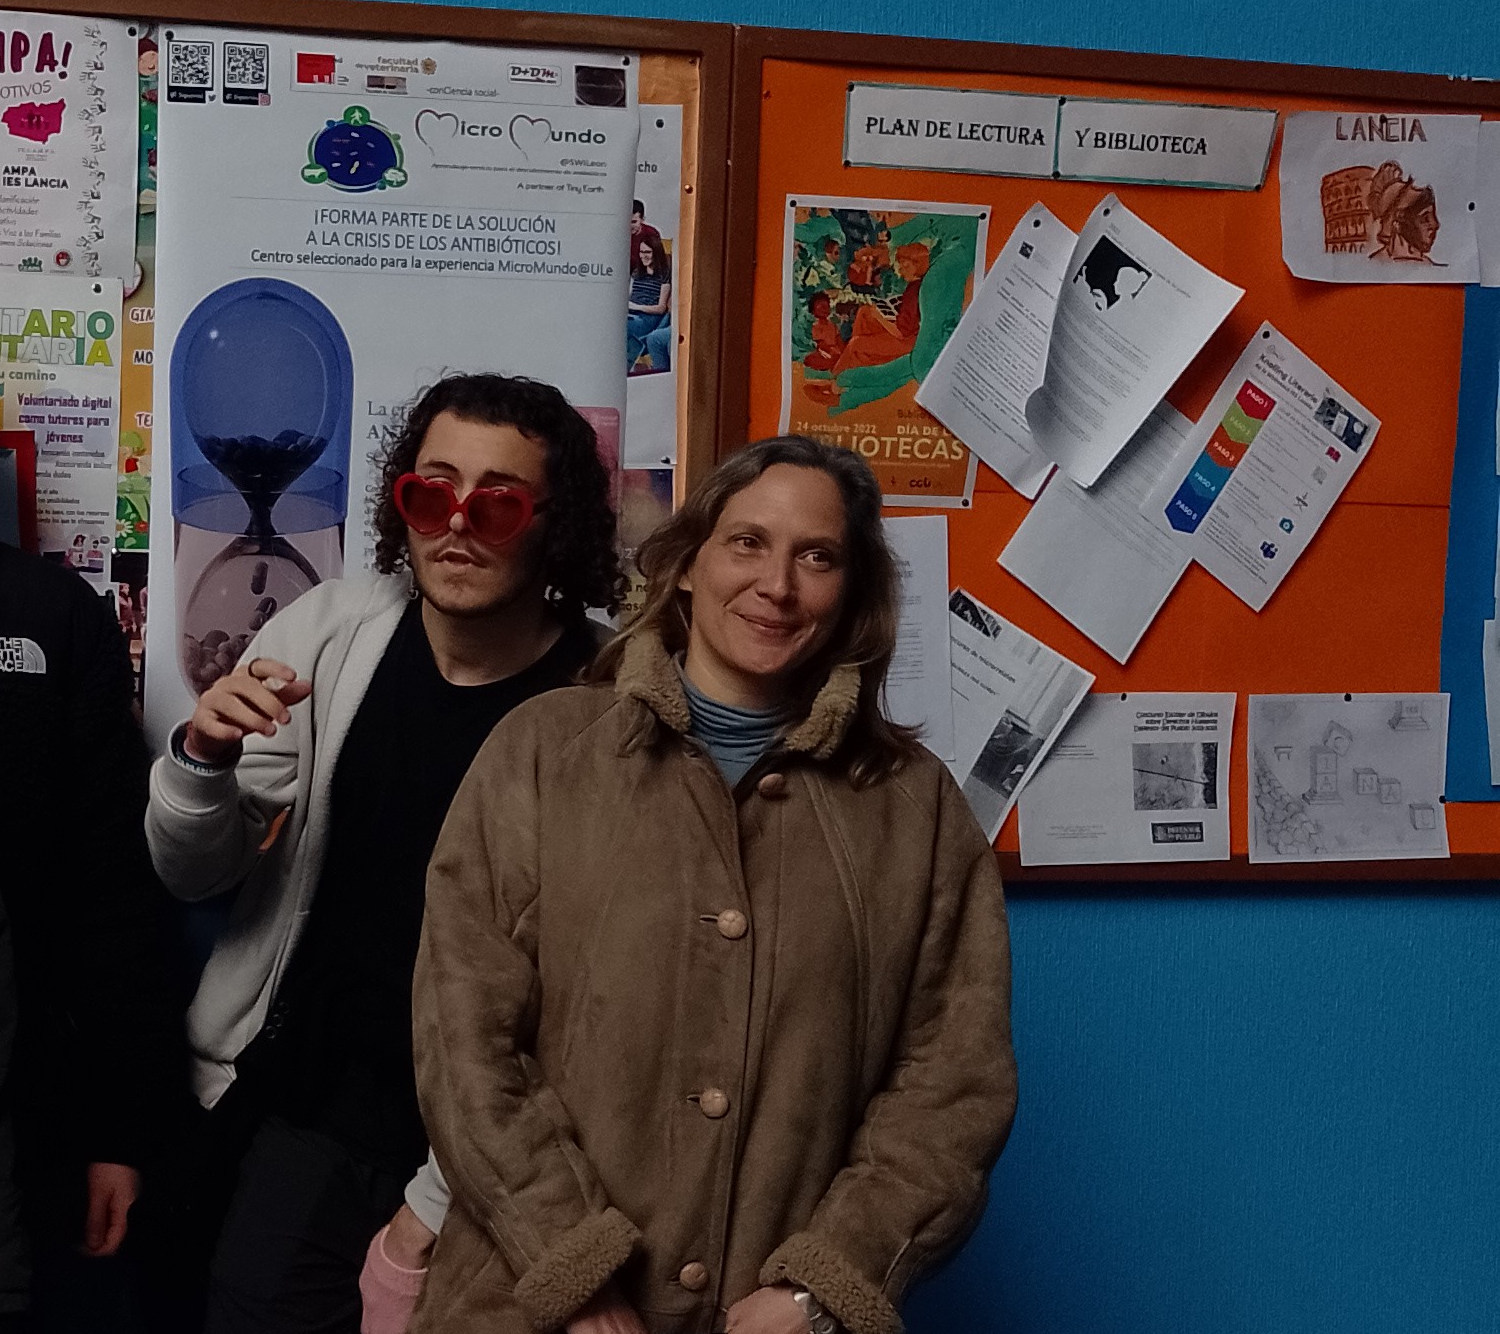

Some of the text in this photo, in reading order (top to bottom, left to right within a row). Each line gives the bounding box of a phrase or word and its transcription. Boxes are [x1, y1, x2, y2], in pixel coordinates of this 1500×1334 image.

[864, 116, 1046, 146] PLAN DE LECTURA
[1335, 116, 1427, 144] LANCIA
[1075, 128, 1208, 155] Y BIBLIOTECA
[2, 165, 37, 176] AMPA
[2, 177, 69, 189] IES LANCIA
[314, 208, 556, 233] ¡FORMA PARTE DE LA SOLUCIÓN
[305, 231, 317, 245] A
[321, 231, 340, 247] LA
[344, 231, 390, 249] CRISIS
[395, 233, 415, 250] DE
[419, 234, 447, 251] LOS
[251, 249, 613, 277] Centro seleccionado para la experiencia MicroMundo@ULe
[8, 370, 57, 382] camino
[1246, 388, 1264, 405] PASO
[367, 400, 387, 416] La
[896, 424, 938, 436] DÍA DE
[1213, 441, 1229, 458] PASO
[1194, 471, 1210, 488] PASO
[1175, 499, 1192, 517] PASO
